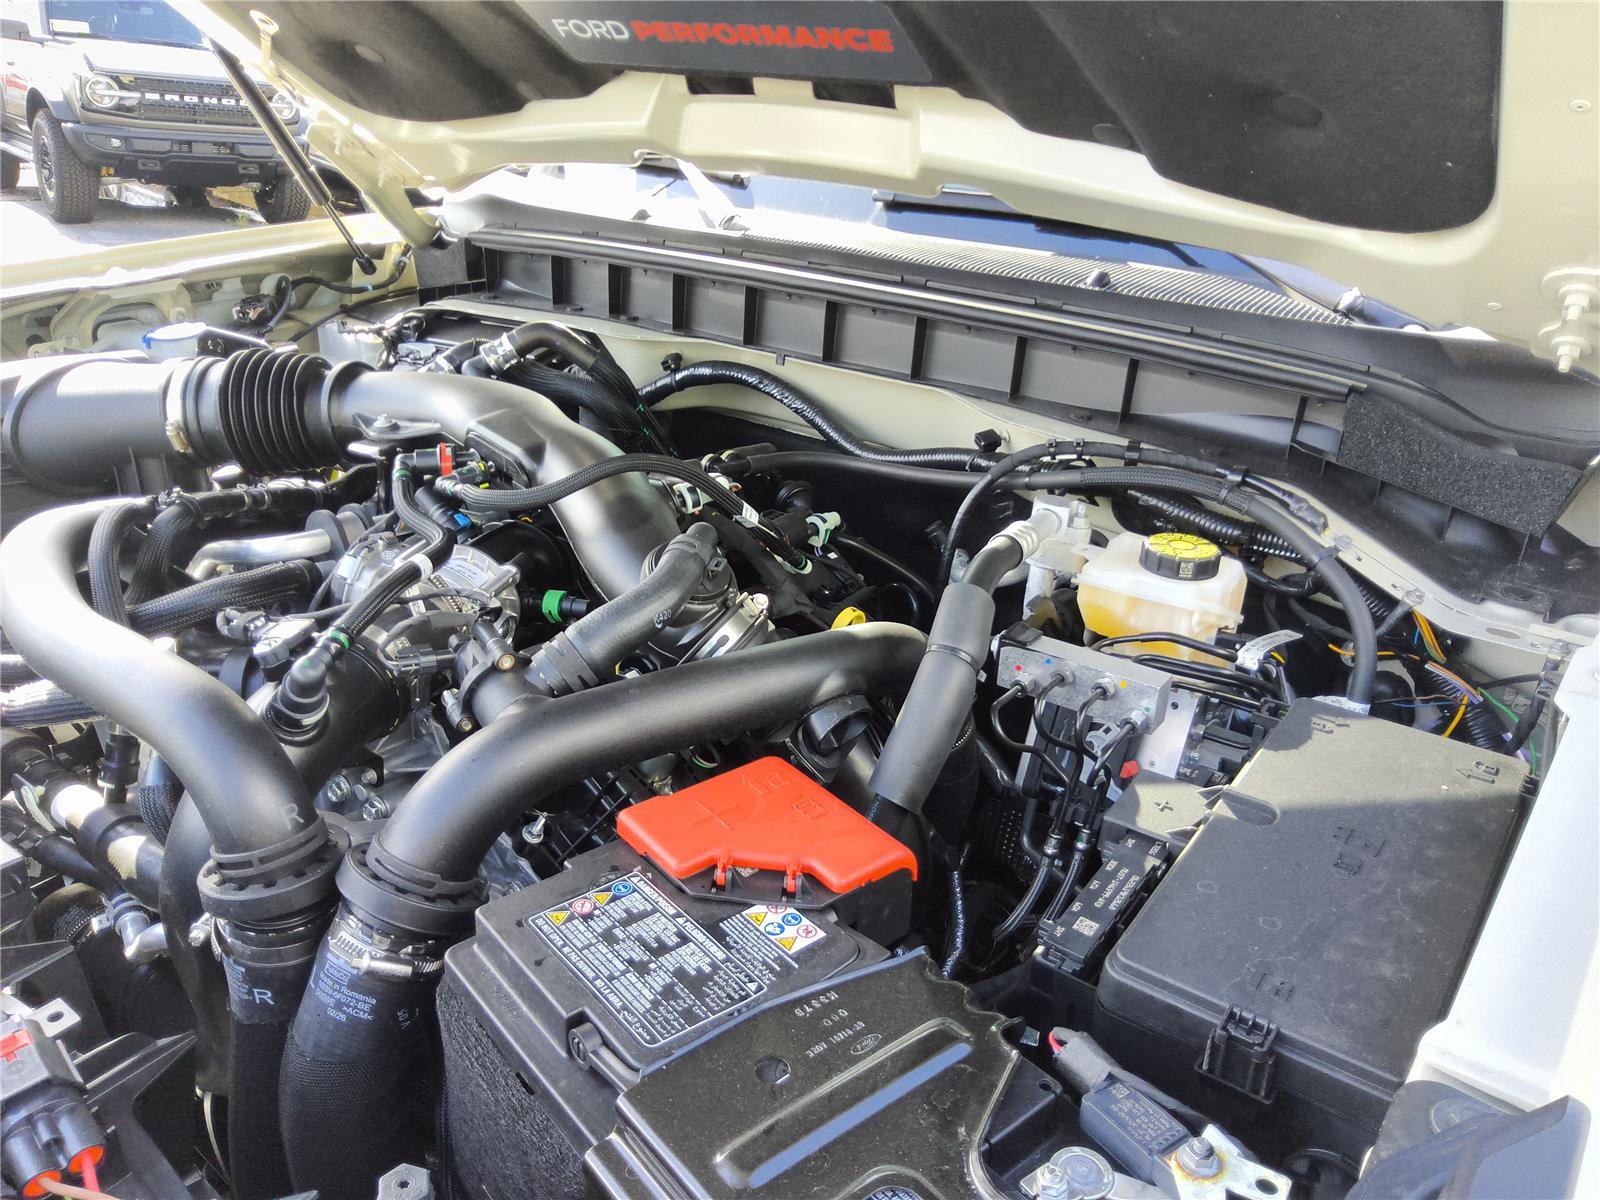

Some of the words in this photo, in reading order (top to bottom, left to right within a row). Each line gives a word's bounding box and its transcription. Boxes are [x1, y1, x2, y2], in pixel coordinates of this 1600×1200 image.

[551, 19, 629, 41] FORD
[630, 20, 894, 53] PERFORMANCE
[253, 989, 275, 1005] R
[341, 986, 376, 1005] Romania
